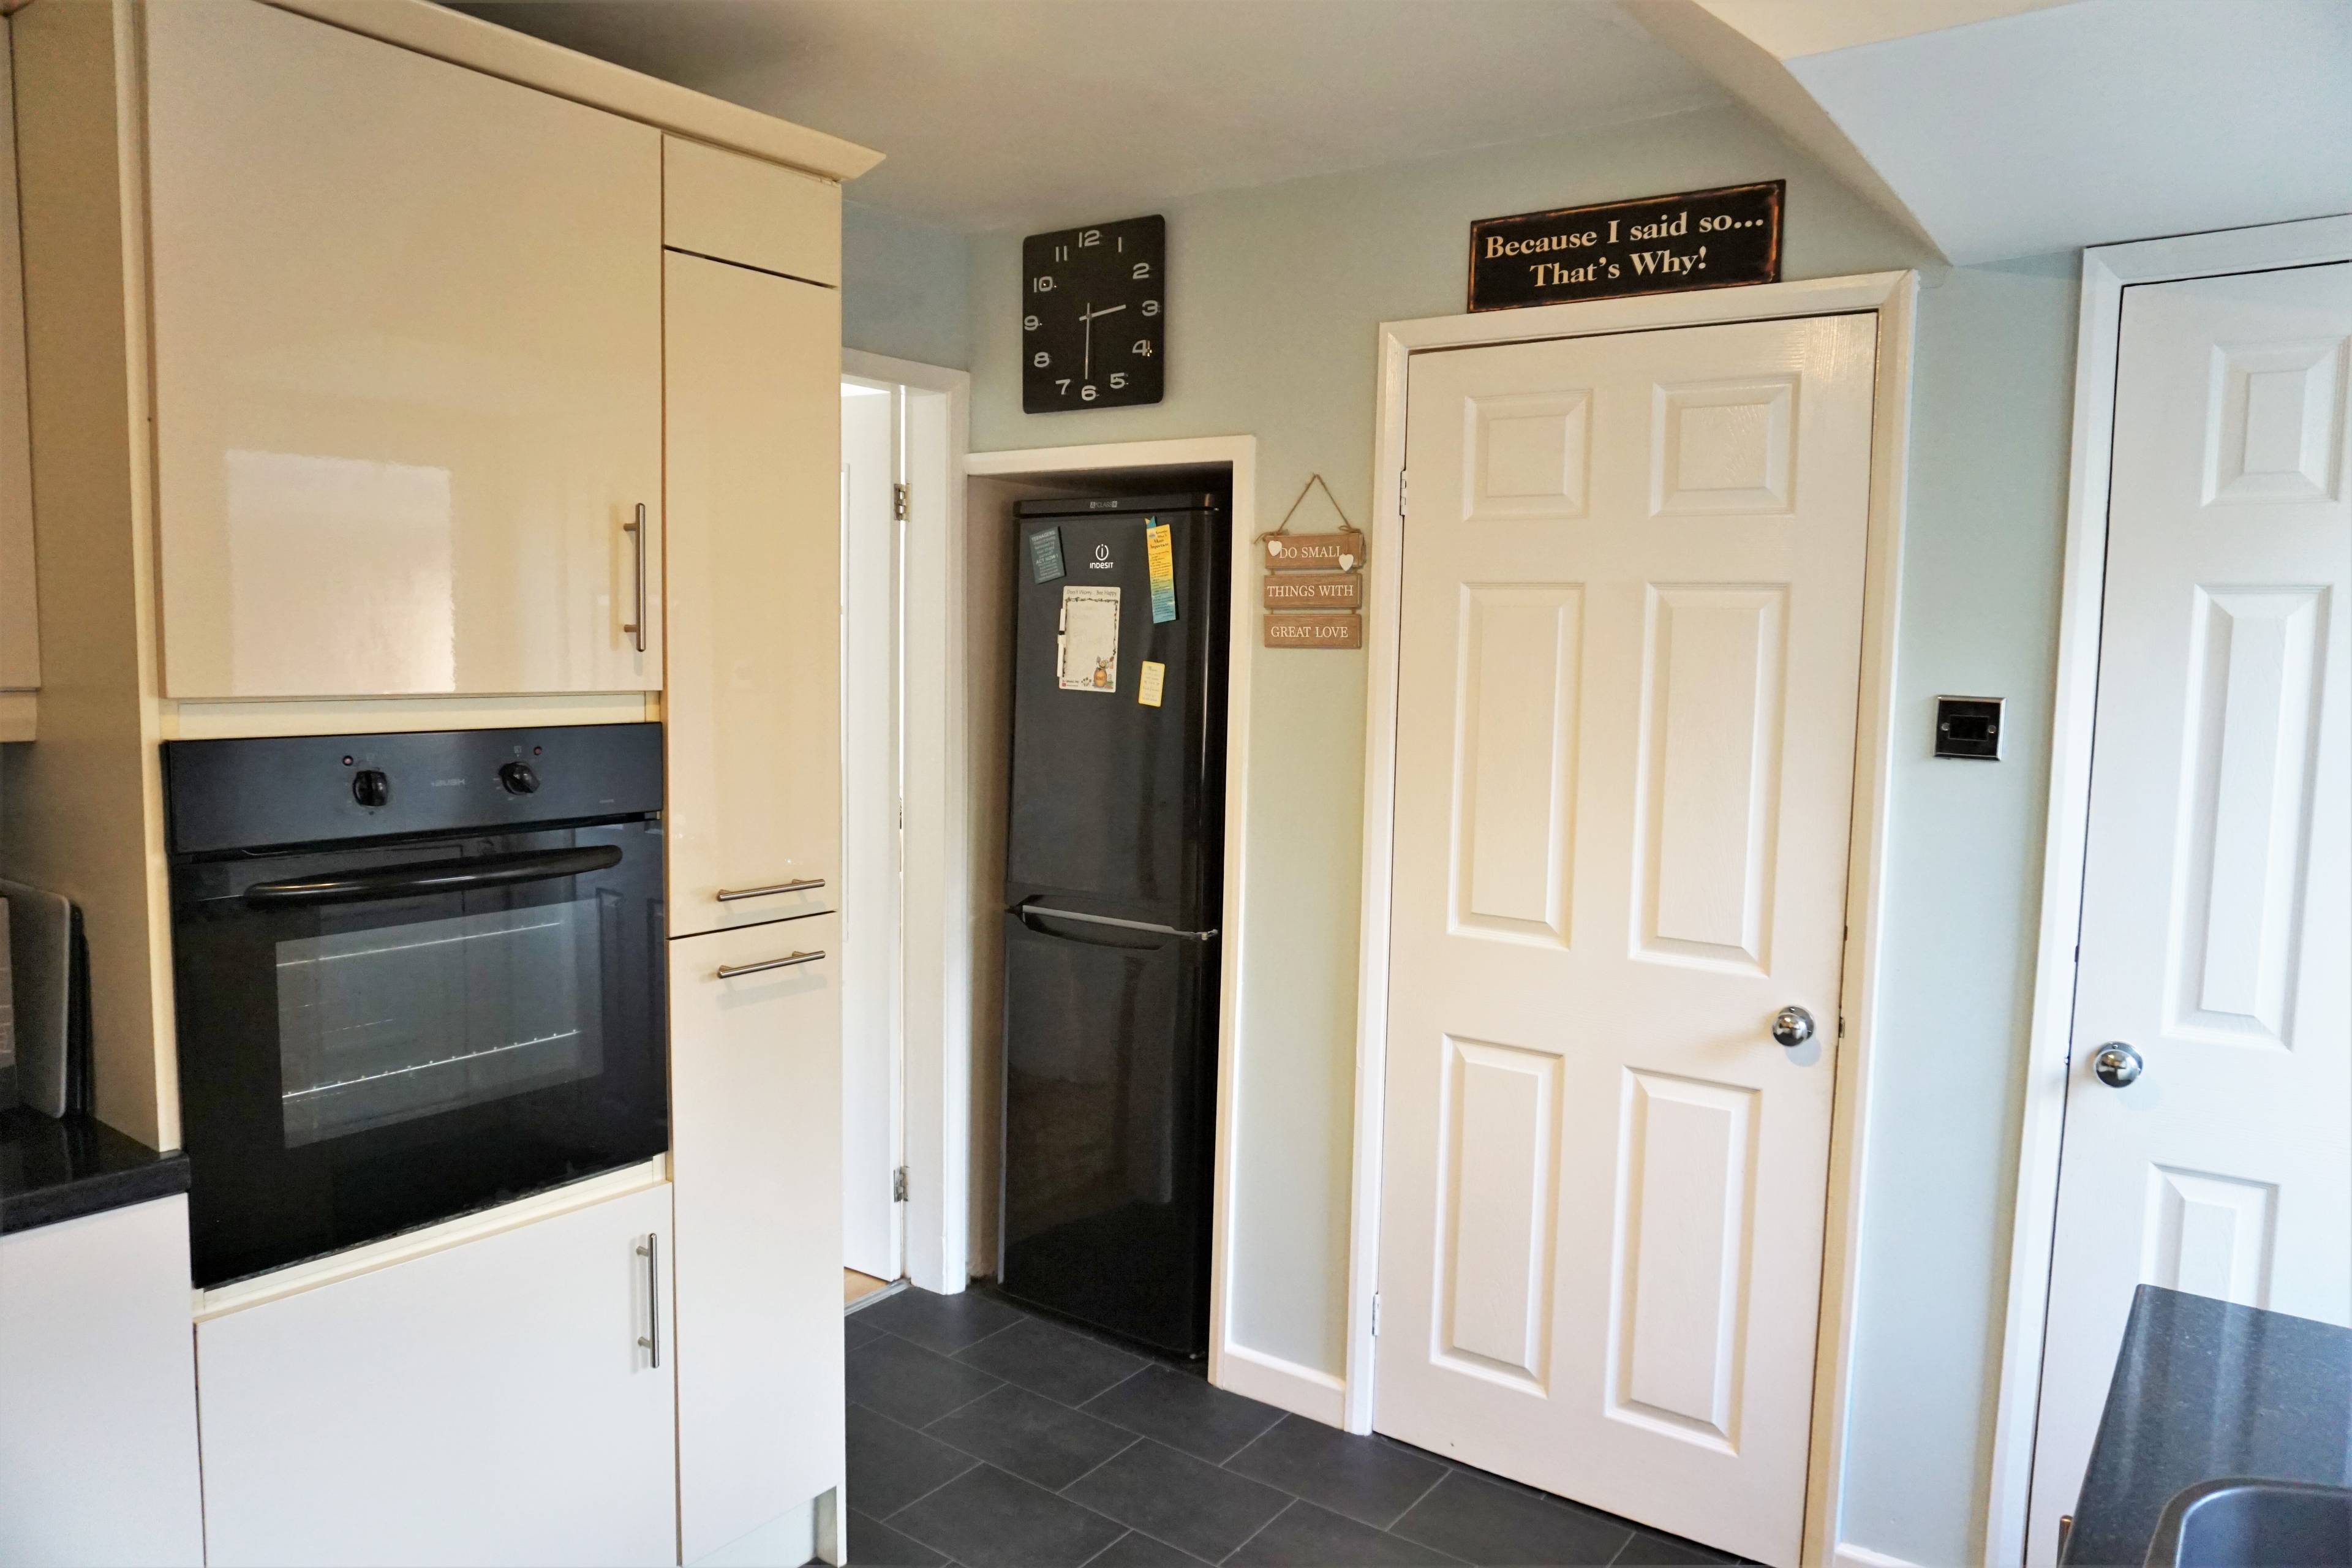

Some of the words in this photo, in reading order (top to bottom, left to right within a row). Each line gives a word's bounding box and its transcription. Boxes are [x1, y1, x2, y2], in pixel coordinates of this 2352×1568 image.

[1079, 230, 1100, 248] 12
[1485, 230, 1597, 259] Because
[1607, 220, 1620, 244] I
[1630, 211, 1687, 241] said
[1698, 213, 1764, 233] so...
[1118, 236, 1122, 253] 1
[1055, 246, 1068, 262] 11
[1133, 263, 1149, 279] 2
[1529, 257, 1620, 288] That's
[1629, 246, 1707, 276] Why!
[1033, 276, 1053, 293] 10
[1142, 300, 1158, 316] 3
[1024, 315, 1039, 331] 9
[1132, 340, 1149, 356] 4
[1034, 352, 1049, 368] 8
[1055, 379, 1071, 395] 7
[1110, 372, 1126, 389] 5
[1081, 385, 1097, 401] 6
[1280, 547, 1297, 559] DO
[1267, 585, 1315, 597] THINGS
[1319, 585, 1354, 597] WITH
[1271, 626, 1311, 638] GREAT
[1315, 626, 1348, 638] LOVE
